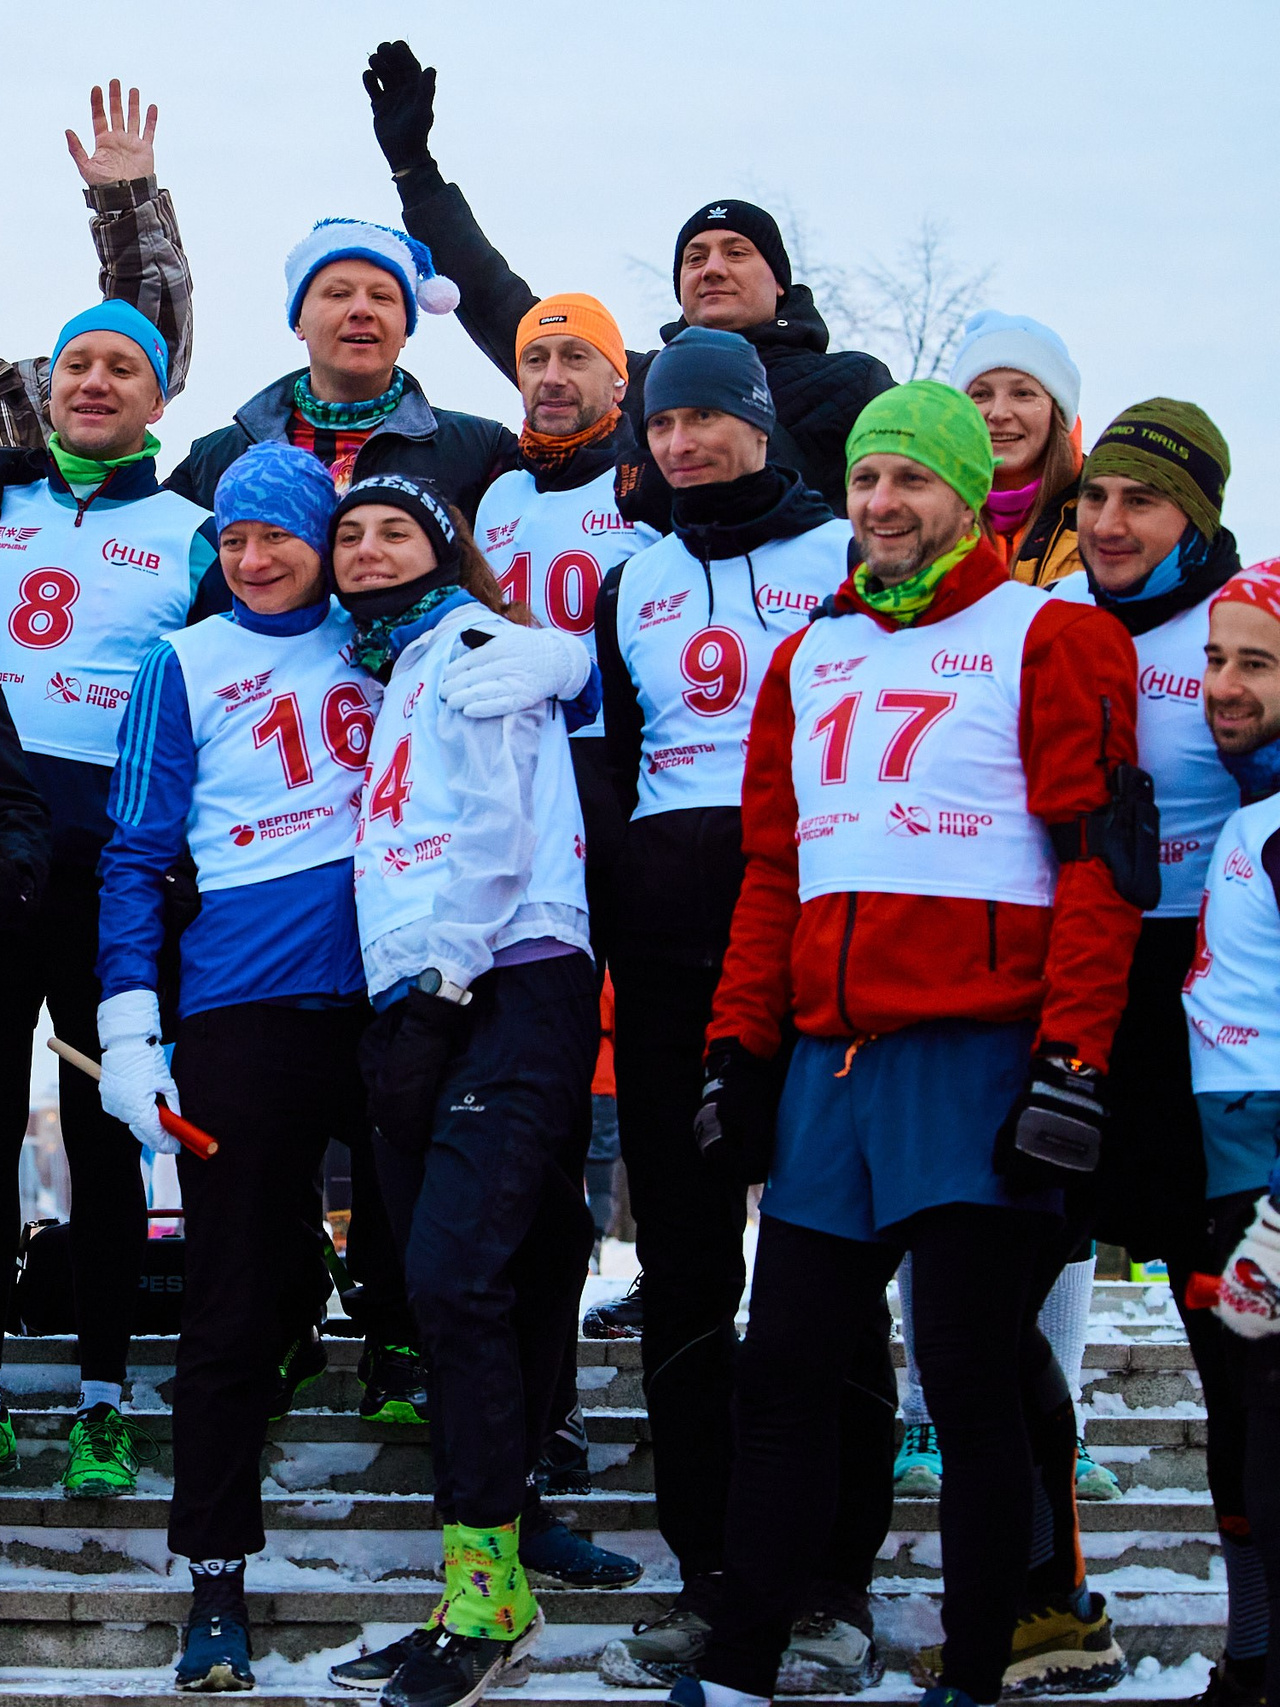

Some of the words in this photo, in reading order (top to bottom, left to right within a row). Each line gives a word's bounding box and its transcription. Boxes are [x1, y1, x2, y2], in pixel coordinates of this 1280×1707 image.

[541, 316, 559, 324] CRAFT
[1142, 428, 1189, 460] TRAILS
[110, 543, 160, 570] НЦВ
[499, 549, 602, 635] 10
[766, 589, 818, 610] НЦВ
[8, 567, 81, 650] 8
[679, 625, 747, 717] 9
[941, 654, 992, 672] НЦВ
[88, 684, 130, 700] ППОО
[1148, 671, 1200, 699] НЦВ
[86, 694, 117, 709] НЦВ
[252, 682, 376, 789] 16
[809, 689, 957, 786] 17
[257, 806, 334, 829] ВЕРТОЛЕТЫ
[939, 811, 992, 826] ППОО
[260, 822, 311, 840] РОССИИ
[939, 823, 978, 838] НЦВ
